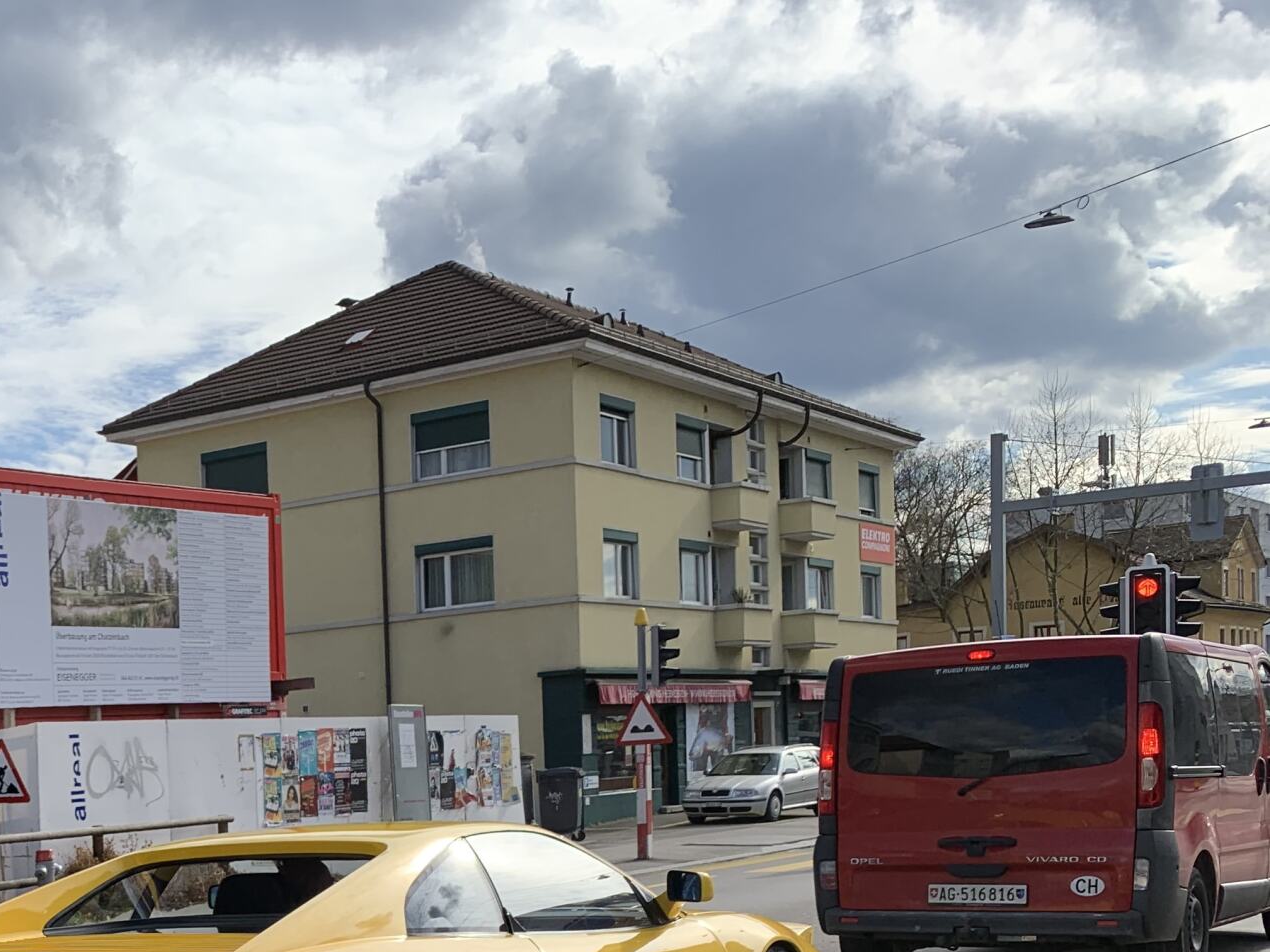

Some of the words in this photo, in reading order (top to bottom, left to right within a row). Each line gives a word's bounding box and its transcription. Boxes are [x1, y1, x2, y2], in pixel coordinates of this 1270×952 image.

[965, 665, 990, 673] TINNER
[69, 734, 87, 821] allreal
[850, 857, 884, 865] OPEL
[1075, 879, 1098, 894] CH
